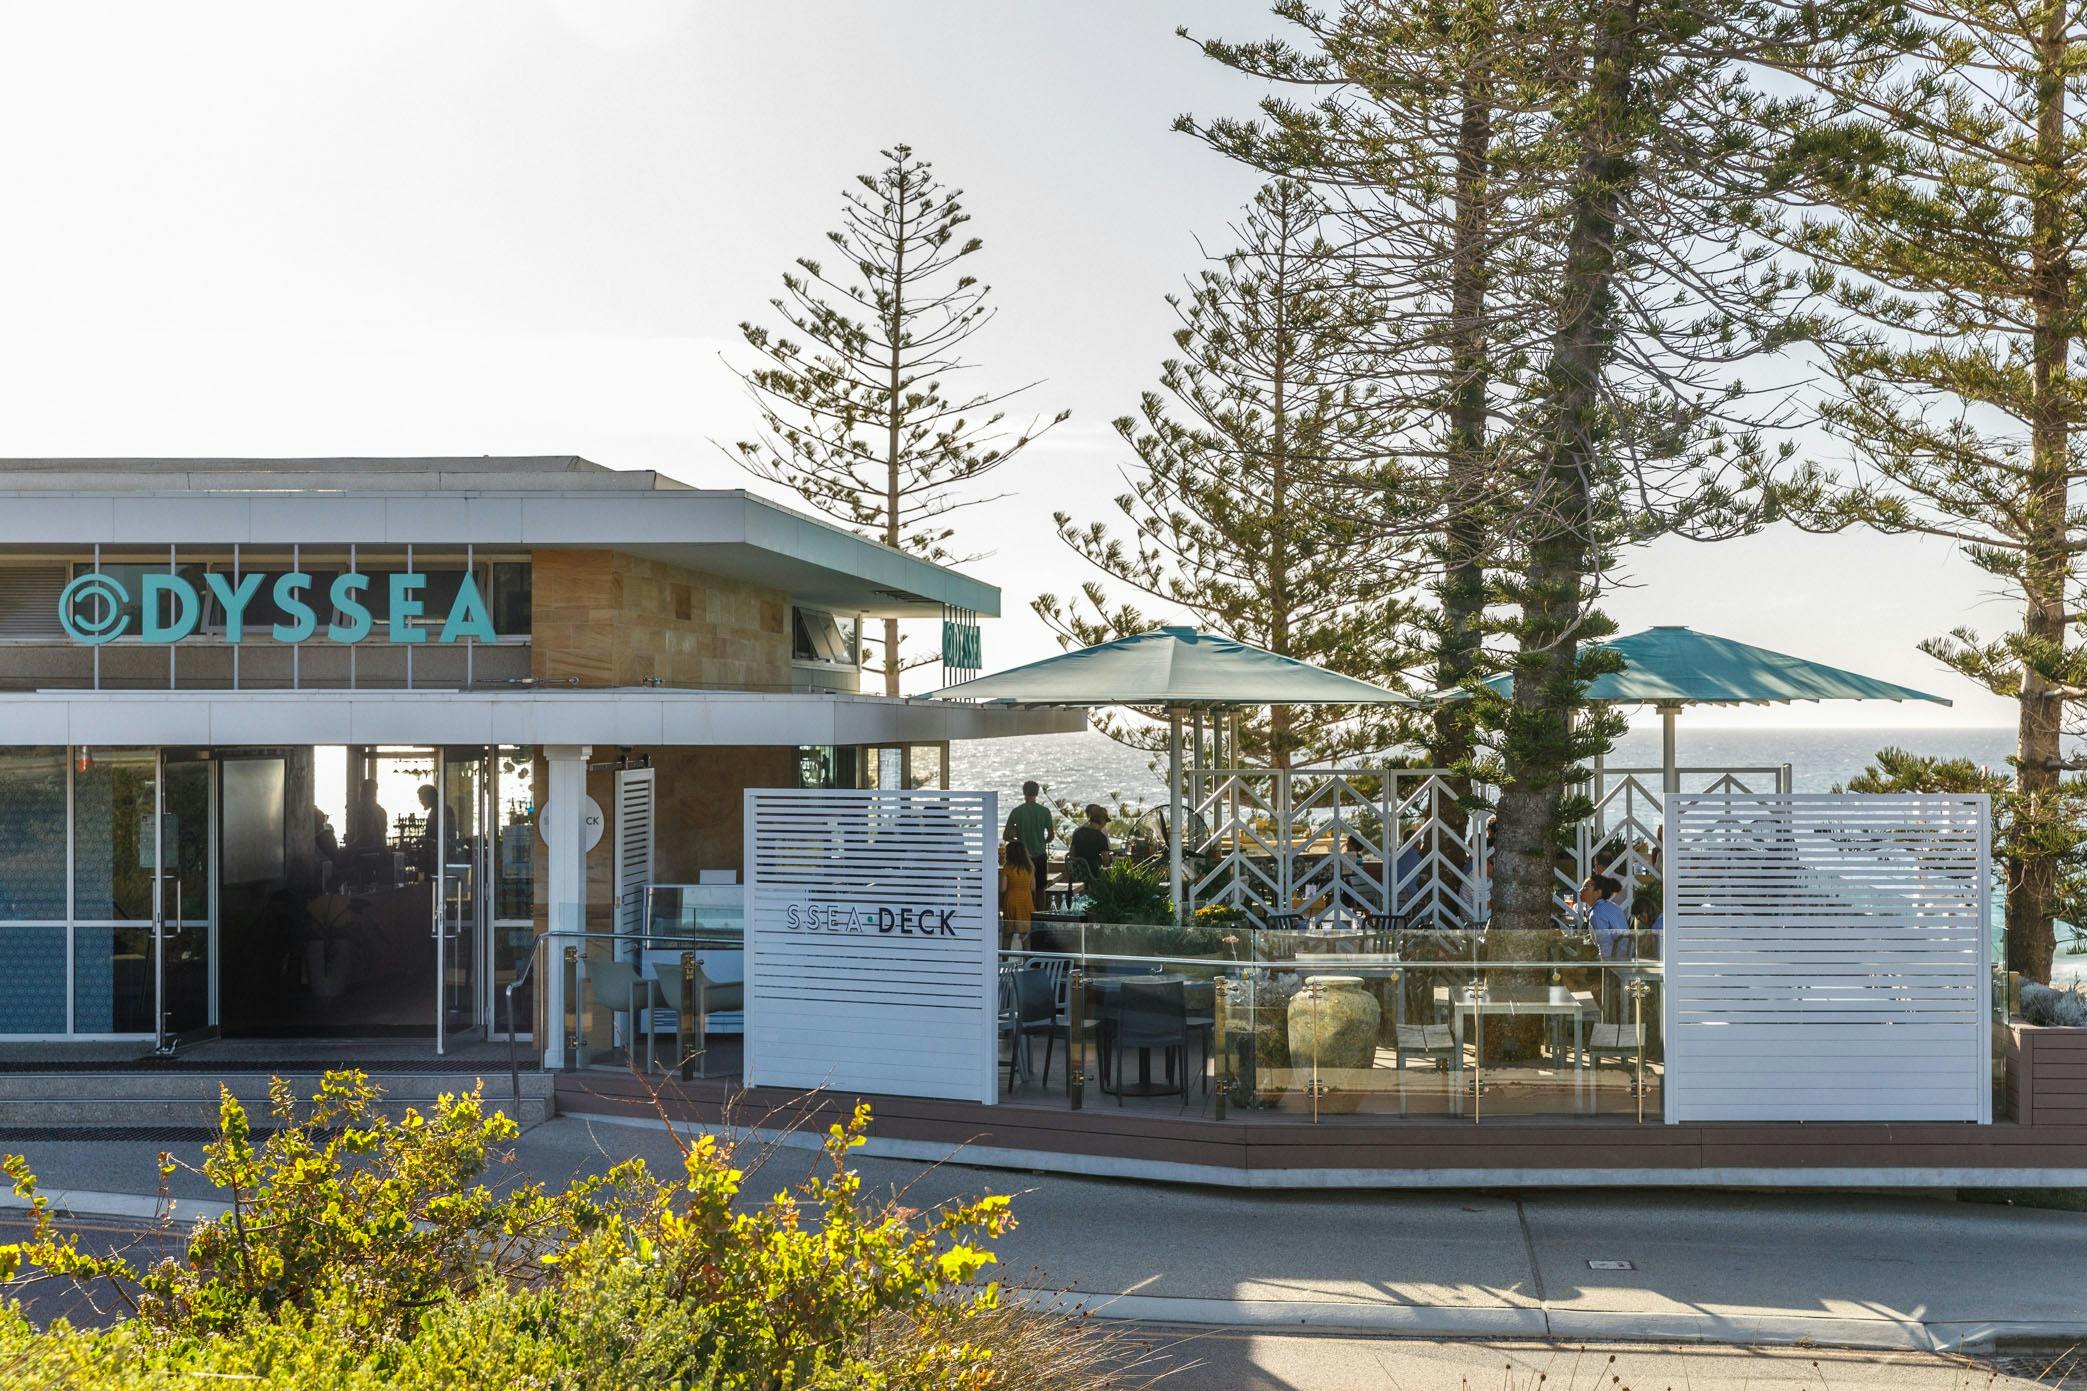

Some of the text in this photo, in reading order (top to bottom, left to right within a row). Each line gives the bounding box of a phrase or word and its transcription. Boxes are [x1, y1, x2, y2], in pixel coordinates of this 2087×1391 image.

[58, 571, 497, 645] ODYSSEA
[786, 903, 957, 936] SSEA DECK
